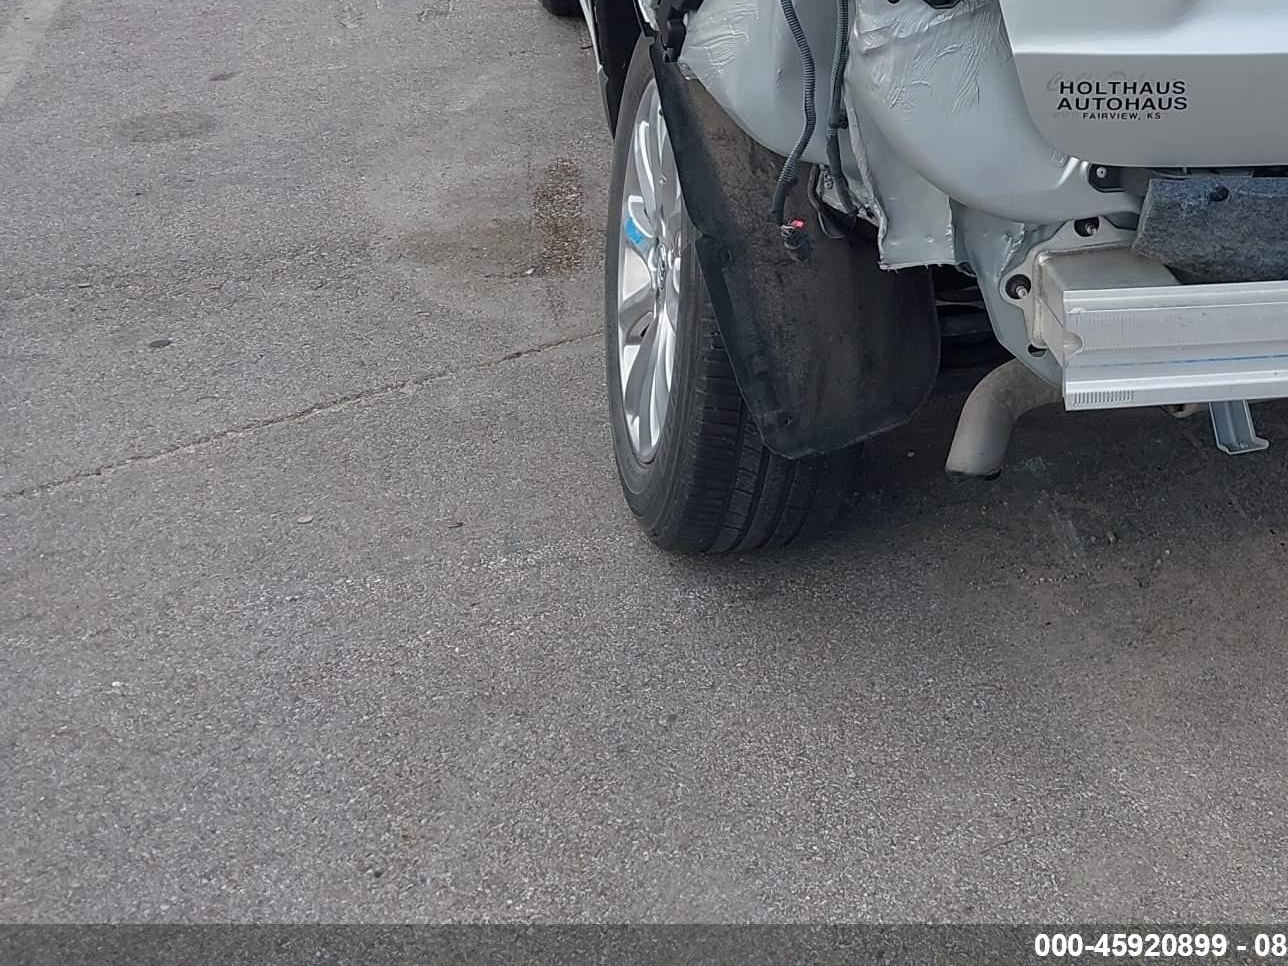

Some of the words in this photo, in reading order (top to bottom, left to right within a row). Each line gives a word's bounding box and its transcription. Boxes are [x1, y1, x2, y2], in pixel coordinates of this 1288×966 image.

[1059, 80, 1186, 95] HOLTHAUS
[1056, 96, 1188, 111] AUTOHAUS
[1082, 112, 1141, 121] FAIRVIEW,
[1146, 112, 1161, 121] KS
